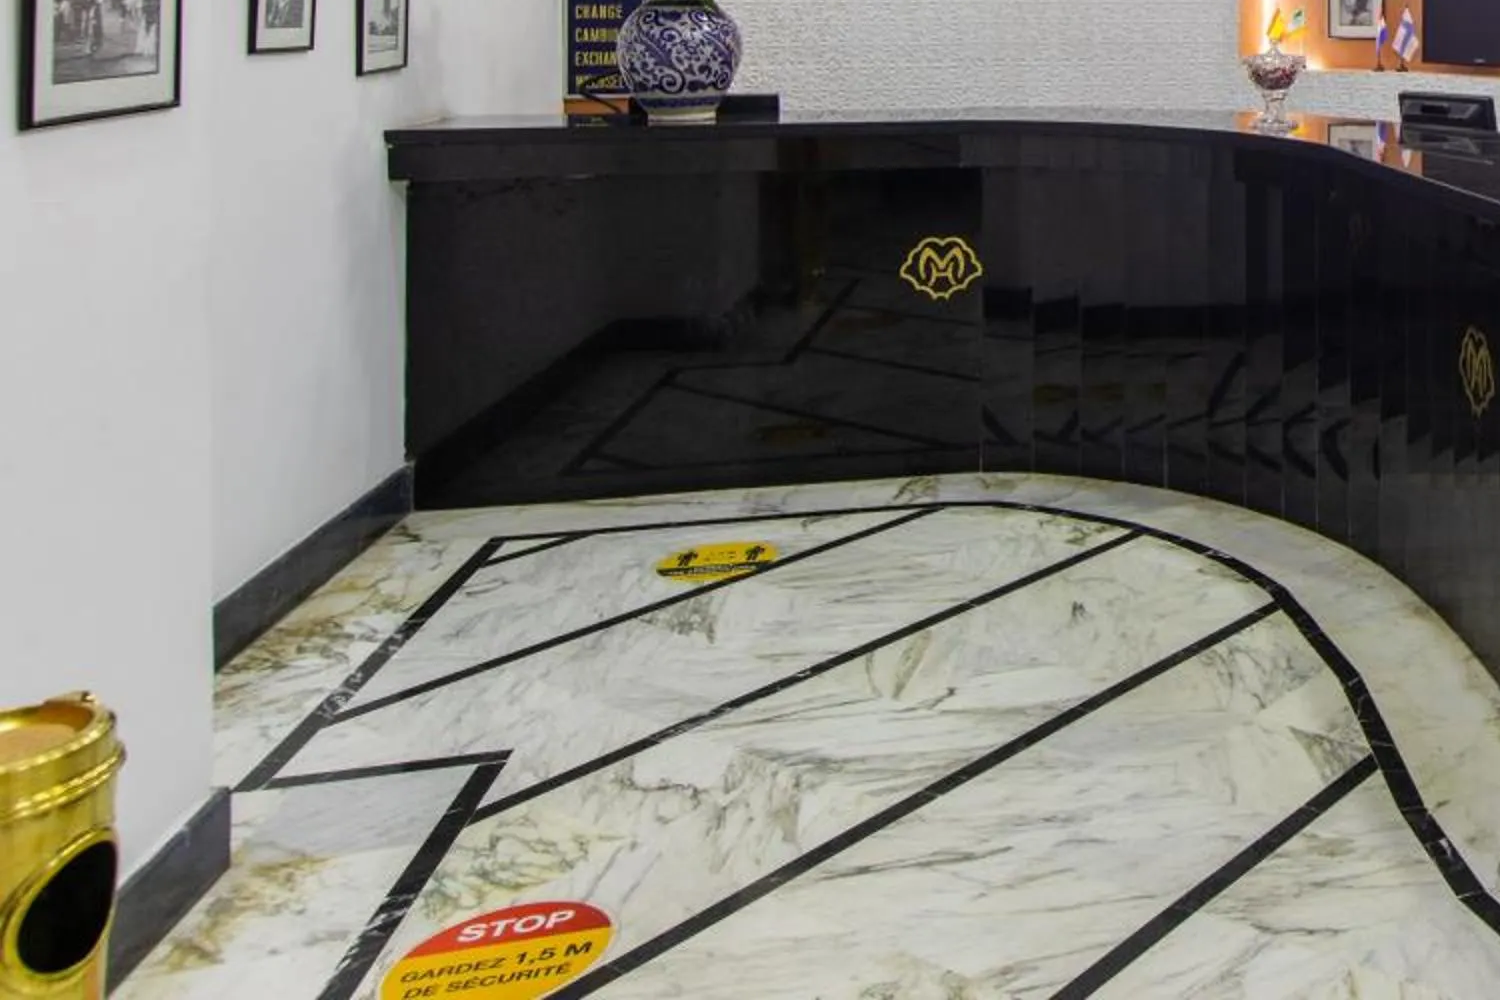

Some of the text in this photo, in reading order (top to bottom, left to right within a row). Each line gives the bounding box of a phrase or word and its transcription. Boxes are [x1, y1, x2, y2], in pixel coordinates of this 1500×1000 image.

[575, 4, 624, 20] CHANGE
[575, 50, 618, 67] EXCHAN
[456, 908, 577, 943] STOP
[400, 940, 593, 983] GARDEZ 1,5 M
[402, 984, 438, 999] DE
